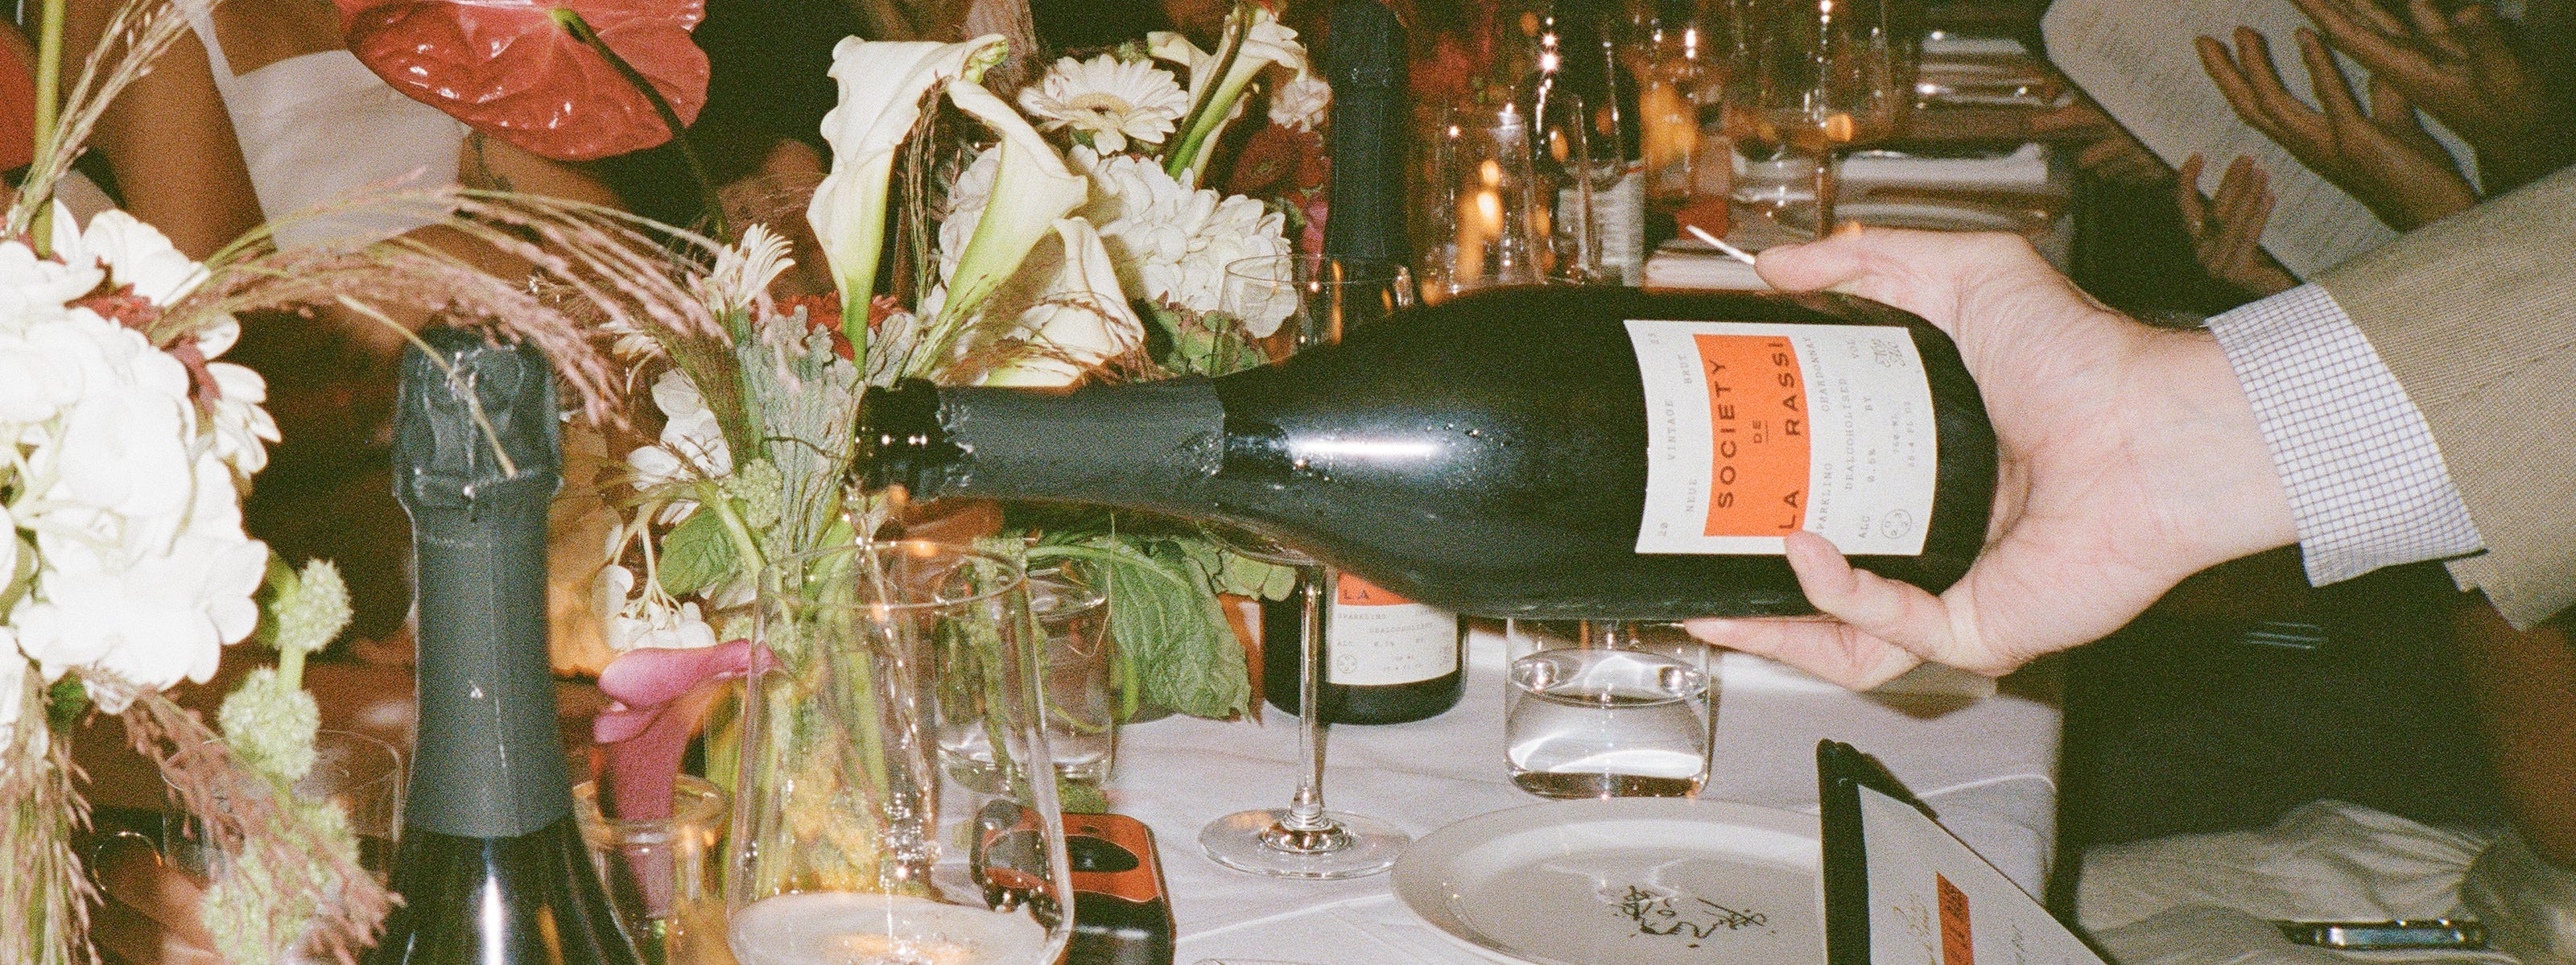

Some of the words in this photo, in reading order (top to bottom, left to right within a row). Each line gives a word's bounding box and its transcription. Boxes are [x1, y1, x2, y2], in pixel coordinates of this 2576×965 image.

[1847, 340, 1860, 359] VOL
[1678, 353, 1692, 384] BRUT
[1802, 337, 1830, 412] CHARDONNAY
[1768, 343, 1801, 436] RASSI
[1864, 396, 1873, 411] BY
[1664, 399, 1677, 460] VINTAGE
[1708, 359, 1736, 509] SOCIETY
[1752, 420, 1762, 444] DE
[1839, 378, 1855, 490] DEALCOHOLISED
[1686, 478, 1697, 512] NEUE
[1778, 490, 1799, 530] LA
[1816, 463, 1832, 534] PARKLING
[1858, 515, 1870, 538] ALC
[1344, 589, 1369, 600] LA
